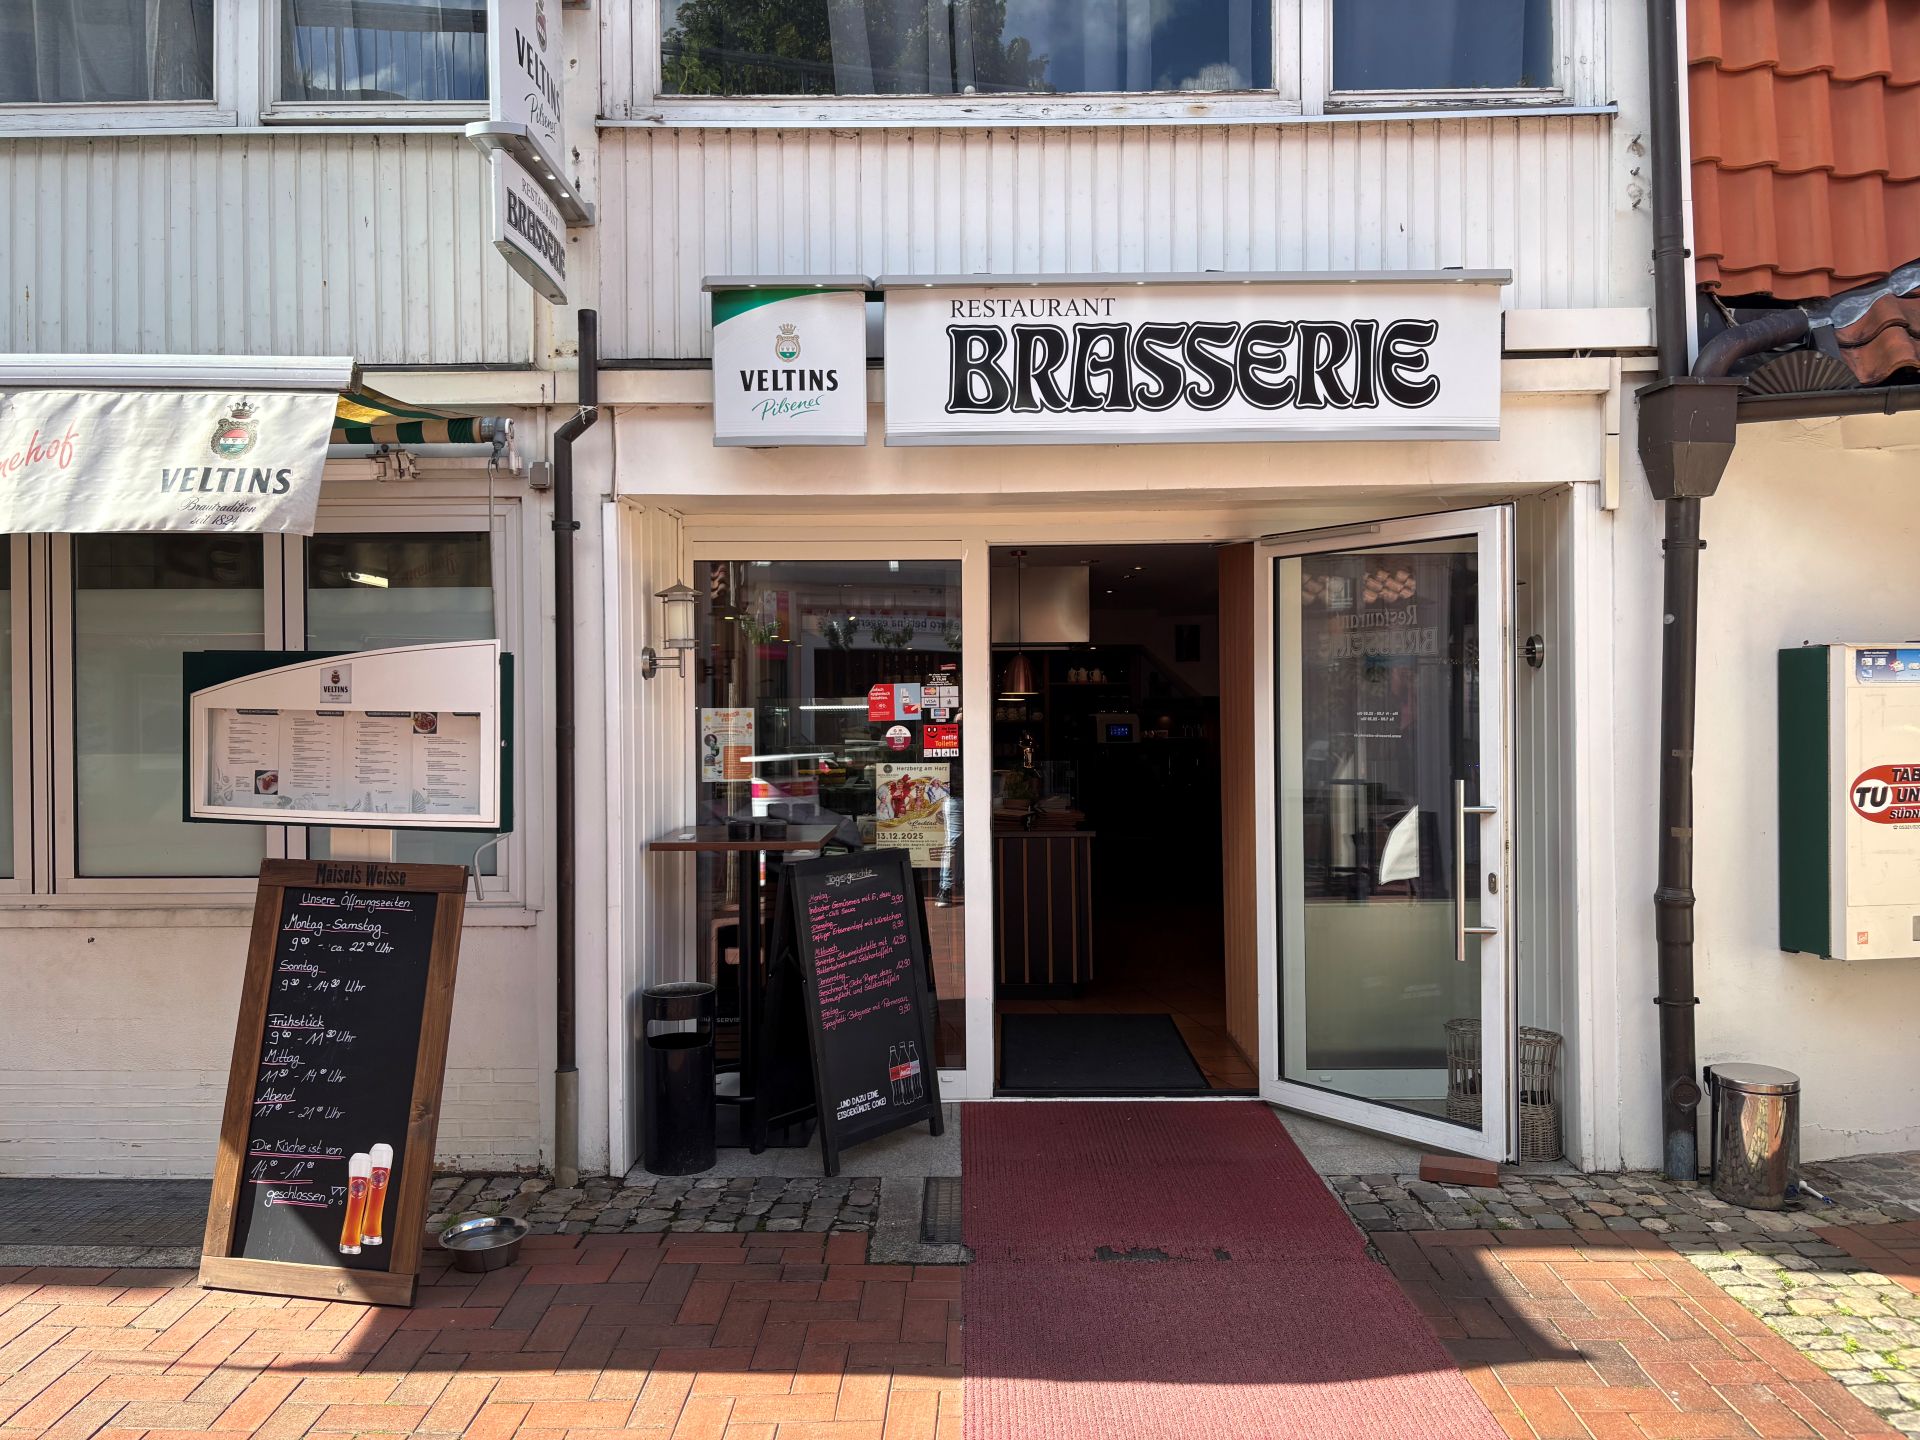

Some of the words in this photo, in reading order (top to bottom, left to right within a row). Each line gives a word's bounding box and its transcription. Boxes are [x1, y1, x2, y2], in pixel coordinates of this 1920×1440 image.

[515, 27, 561, 123] VELTINS
[525, 93, 557, 142] Pilsener
[522, 177, 558, 231] RESTAURANT
[507, 186, 566, 281] BRASSERIE
[950, 298, 1116, 319] RESTAURANT
[945, 319, 1440, 414] BRASSERIE
[740, 369, 839, 391] VELTINS
[751, 395, 824, 421] Pilsener
[160, 466, 292, 494] VELTINS
[178, 497, 257, 513] Brautradition
[190, 514, 210, 525] seit
[211, 514, 240, 526] 1824
[323, 685, 349, 693] VELTINS
[1855, 786, 1889, 807] TU
[876, 832, 924, 840] 13.12.2025
[315, 863, 362, 885] Maisel's
[366, 864, 407, 886] Weisse
[825, 867, 876, 887] Tagesgerichte
[302, 893, 336, 904] Unsere
[340, 891, 411, 913] Öffnungszeiten
[284, 913, 323, 937] Montag
[332, 918, 383, 940] Samstag
[330, 944, 345, 952] ca.
[374, 942, 395, 953] Uhr
[279, 960, 319, 978] Sonntag
[345, 979, 367, 993] Uhr
[268, 1012, 325, 1027] Frühstück
[336, 1030, 357, 1044] Uhr
[264, 1049, 300, 1068] Mittag
[327, 1069, 347, 1083] Uhr
[257, 1088, 296, 1102] Abend
[851, 1093, 867, 1105] DAZU
[867, 1089, 880, 1099] EINE
[324, 1105, 345, 1119] Uhr
[251, 1137, 272, 1152] Die
[275, 1137, 306, 1153] Küche
[307, 1139, 322, 1154] ist
[325, 1146, 342, 1155] von
